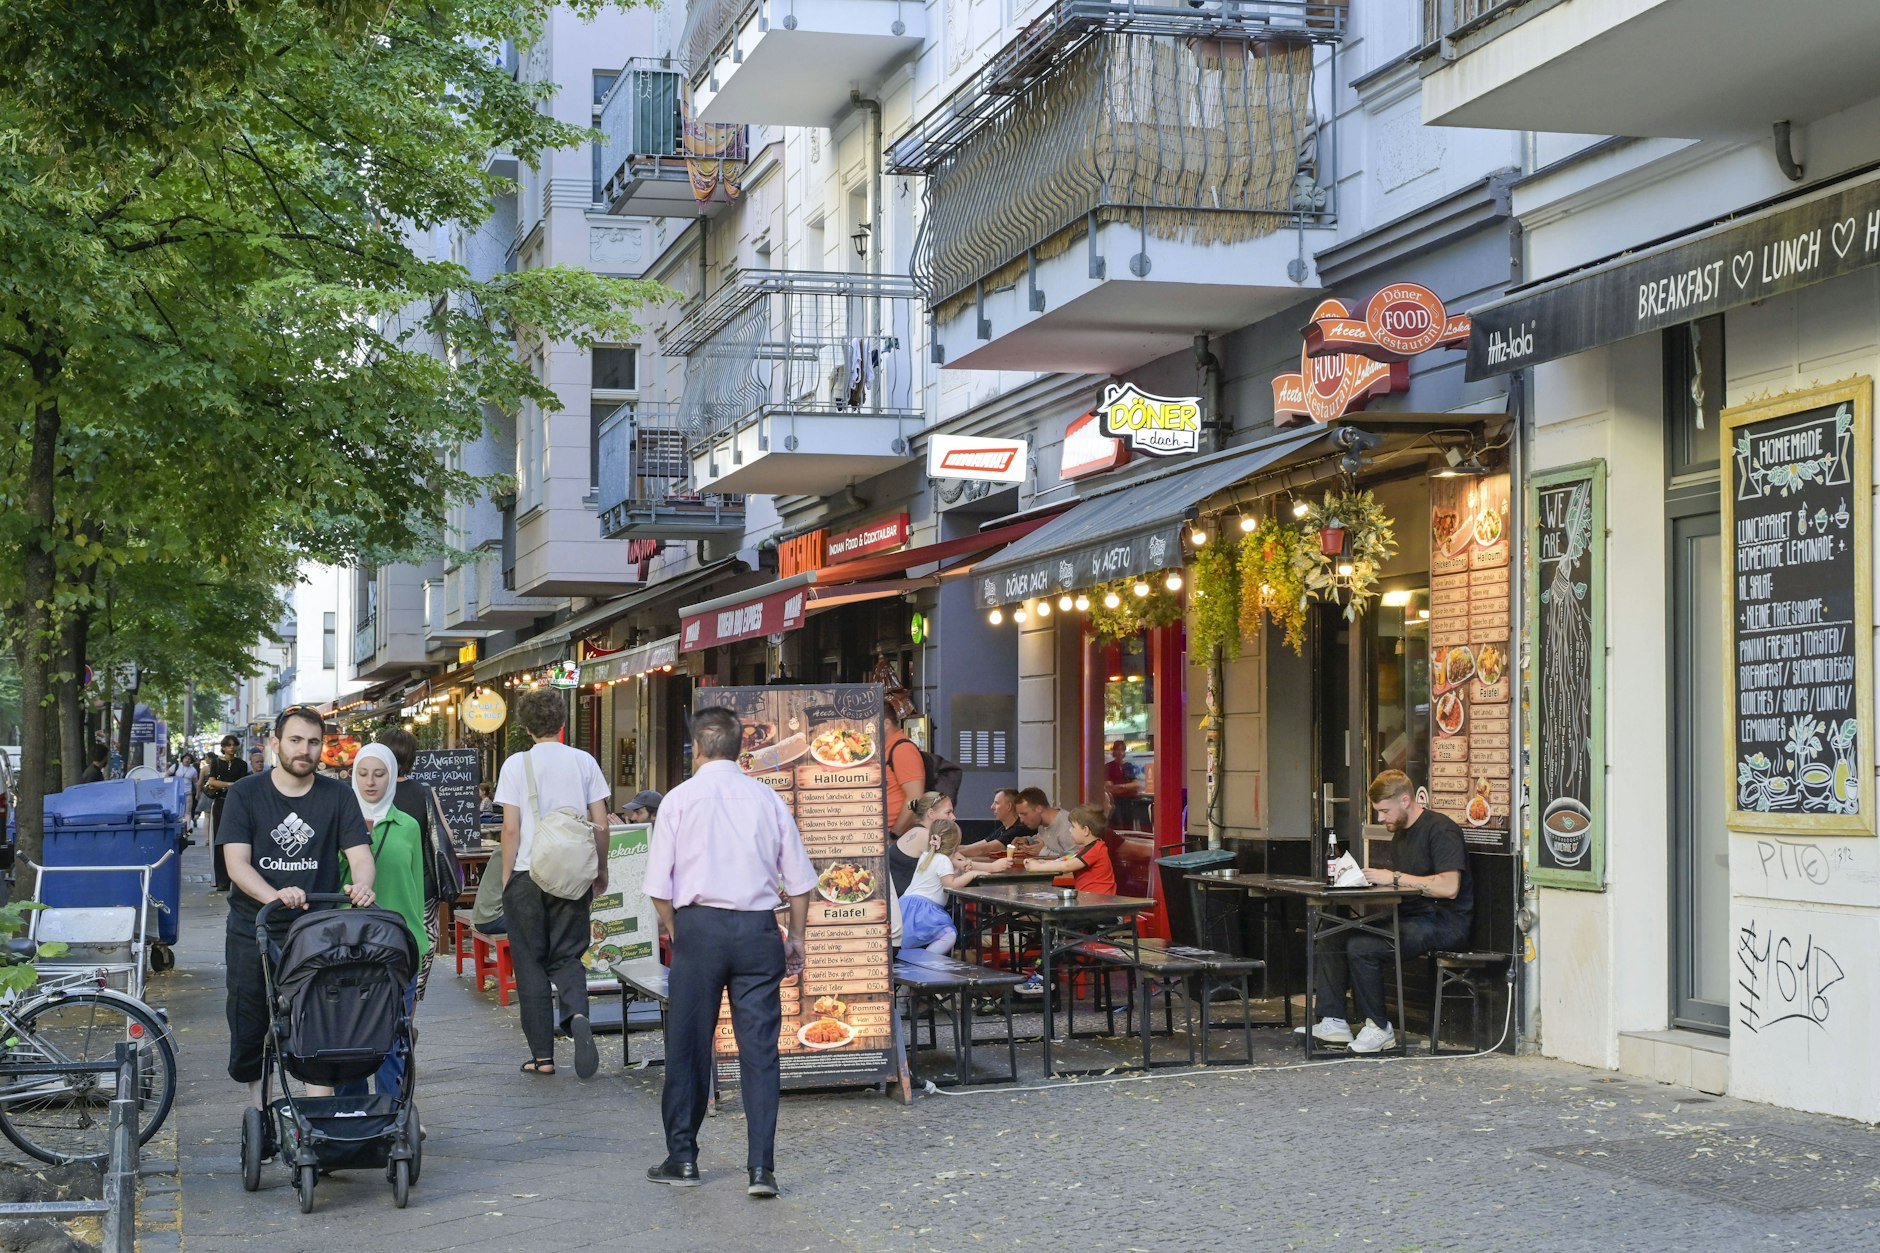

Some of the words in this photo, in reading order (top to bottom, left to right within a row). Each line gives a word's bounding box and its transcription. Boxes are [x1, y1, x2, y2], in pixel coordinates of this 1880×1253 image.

[1638, 260, 1723, 320] BREAKFAST
[1762, 228, 1822, 283] LUNCH
[1865, 209, 1880, 252] H
[1382, 289, 1422, 304] Döner
[1329, 322, 1367, 338] Aceto
[1444, 320, 1471, 336] Loka
[1384, 310, 1429, 330] FOOD
[1374, 322, 1441, 351] Restaurant
[1279, 380, 1302, 403] Aceto
[1110, 397, 1198, 431] DÖNER
[1149, 431, 1181, 447] dach
[1759, 428, 1823, 466] HOMEMADE
[1545, 493, 1565, 529] WE
[829, 542, 845, 556] INDIAN
[845, 537, 858, 551] FOOD
[863, 525, 898, 544] COCKTAILBAR
[1738, 511, 1792, 544] LUNCHPAKET
[1477, 551, 1503, 562] Halloumi
[1543, 531, 1562, 558] ARE
[1738, 542, 1784, 572] HOMEMADE
[1786, 535, 1834, 566] LEMONADE
[1092, 554, 1100, 575] by
[1102, 546, 1131, 573] ACETO
[1005, 573, 1028, 597] DÖNER
[1029, 570, 1048, 592] DACH
[1746, 602, 1772, 630] KLEINE
[1773, 598, 1823, 627] TAGESSUPPE
[1739, 637, 1765, 663] PANINI
[1766, 633, 1801, 660] FRESHLY
[1740, 661, 1784, 690] BREAKFAST
[1792, 658, 1834, 685] SCRAMBLED
[846, 690, 875, 707] FOOD
[1740, 690, 1774, 715] QUICHES
[1783, 687, 1809, 713] SOUPS
[1740, 716, 1787, 742] LEMONADES
[423, 753, 477, 770] ANGEBOTE
[815, 773, 869, 783] Halloumi
[259, 856, 318, 871] Columbia
[824, 908, 866, 918] Falafel
[807, 929, 826, 937] Falafel
[808, 956, 826, 965] Falafel
[827, 956, 839, 964] Box
[808, 971, 827, 979] Falafel
[852, 1004, 885, 1012] Pommes
